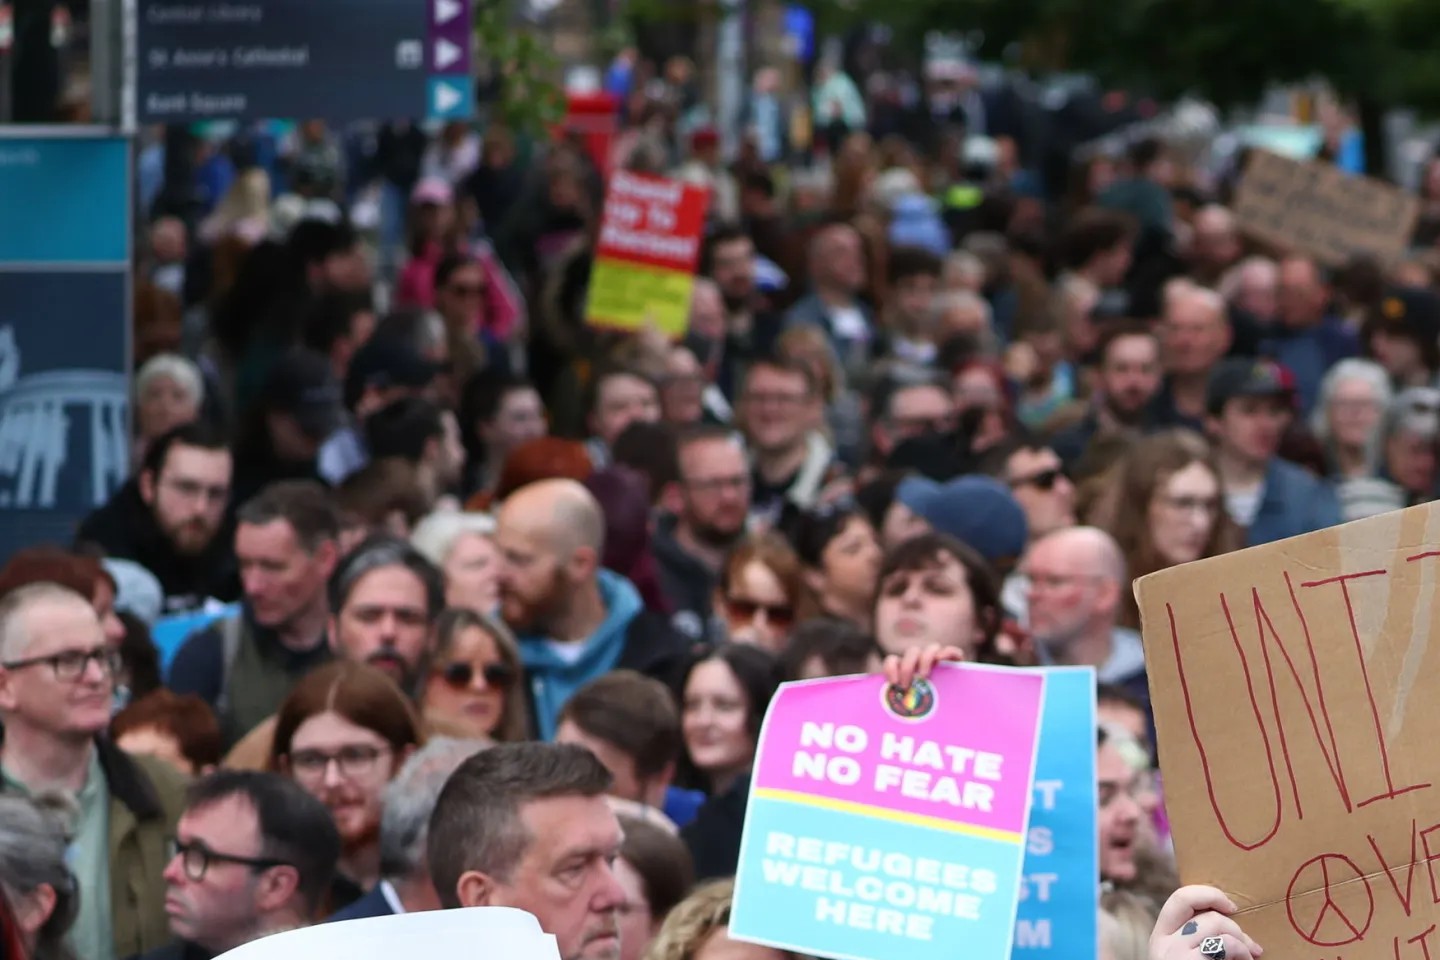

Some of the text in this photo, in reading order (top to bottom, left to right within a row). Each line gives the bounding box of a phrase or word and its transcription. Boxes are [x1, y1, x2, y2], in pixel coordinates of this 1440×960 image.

[792, 751, 861, 786] NO
[874, 764, 996, 813] FEAR
[801, 722, 1005, 782] NO HATE
[762, 859, 983, 921] WELCOME
[766, 831, 998, 895] REFUGEES
[815, 898, 935, 942] HERE
